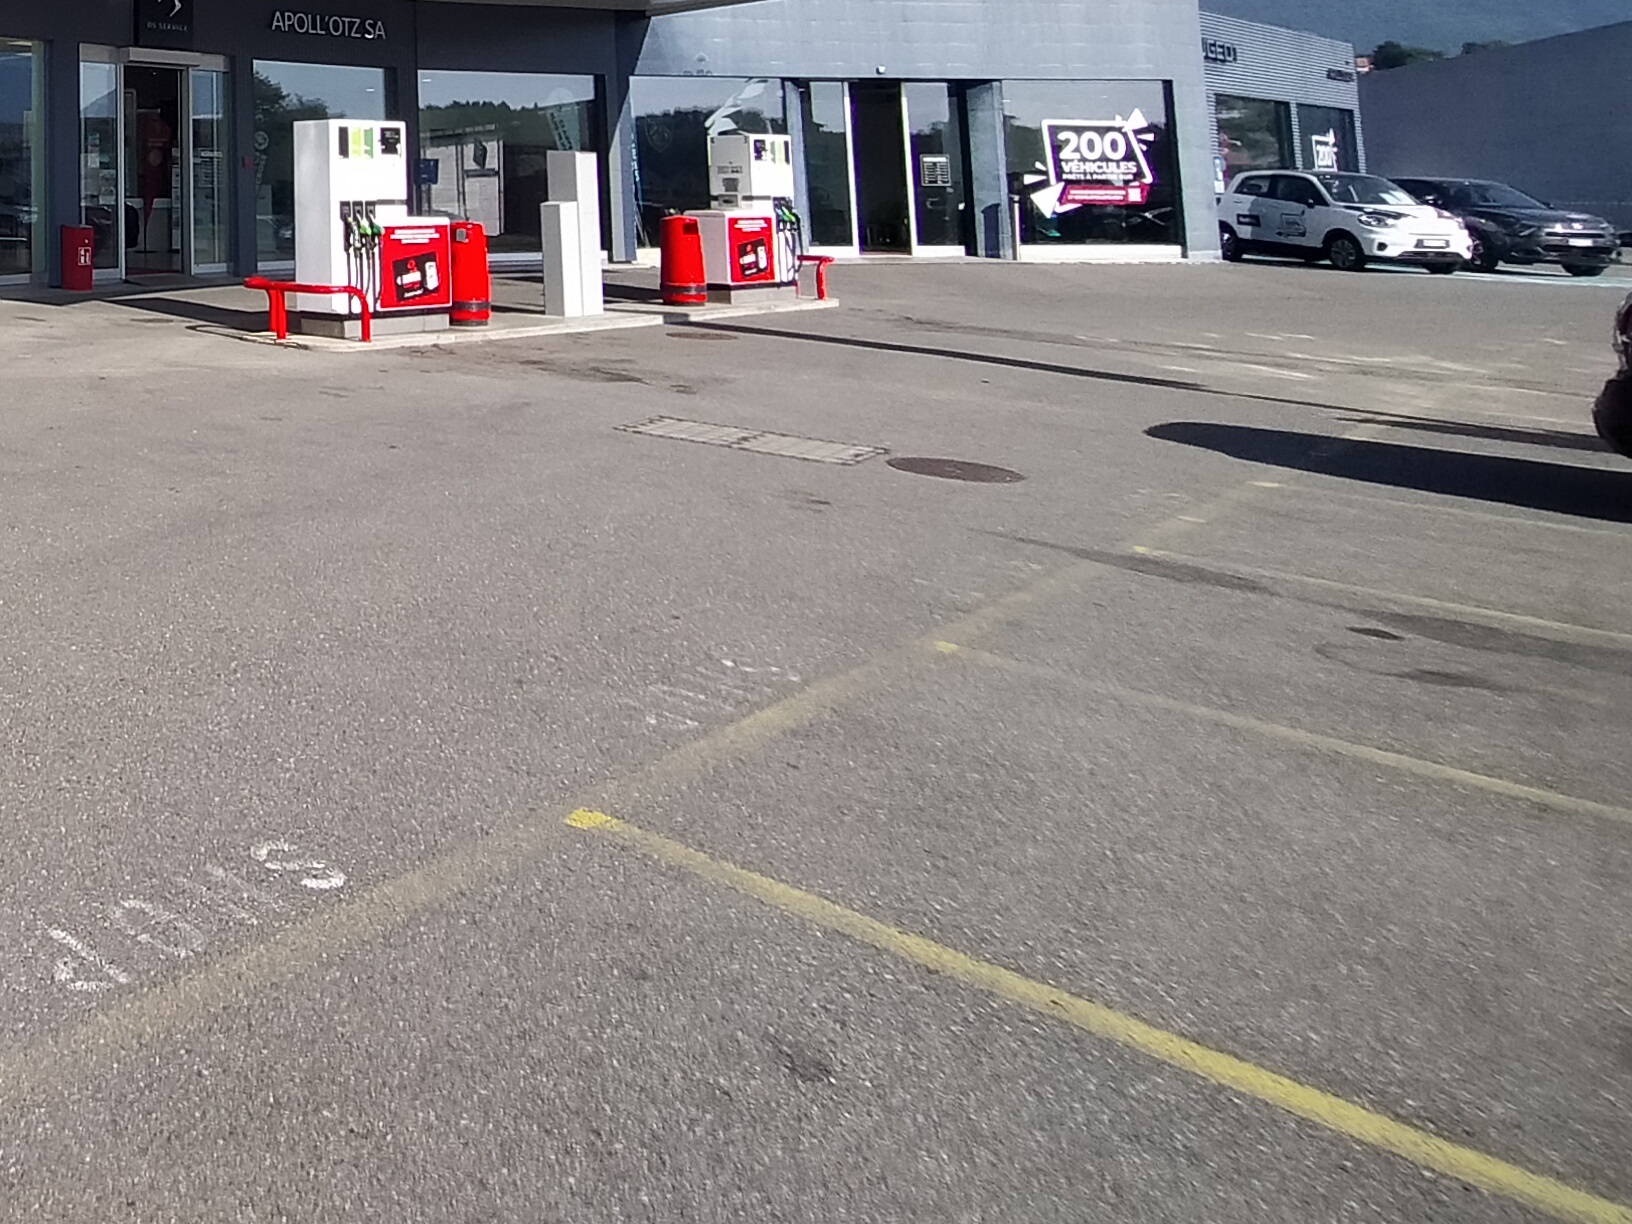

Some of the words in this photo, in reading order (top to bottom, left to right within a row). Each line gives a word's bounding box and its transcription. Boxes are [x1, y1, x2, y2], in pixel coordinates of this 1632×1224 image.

[271, 11, 361, 38] APOLL'OTZ
[364, 19, 386, 40] SA
[1057, 131, 1127, 160] 200
[1060, 159, 1137, 174] VÉHICULES
